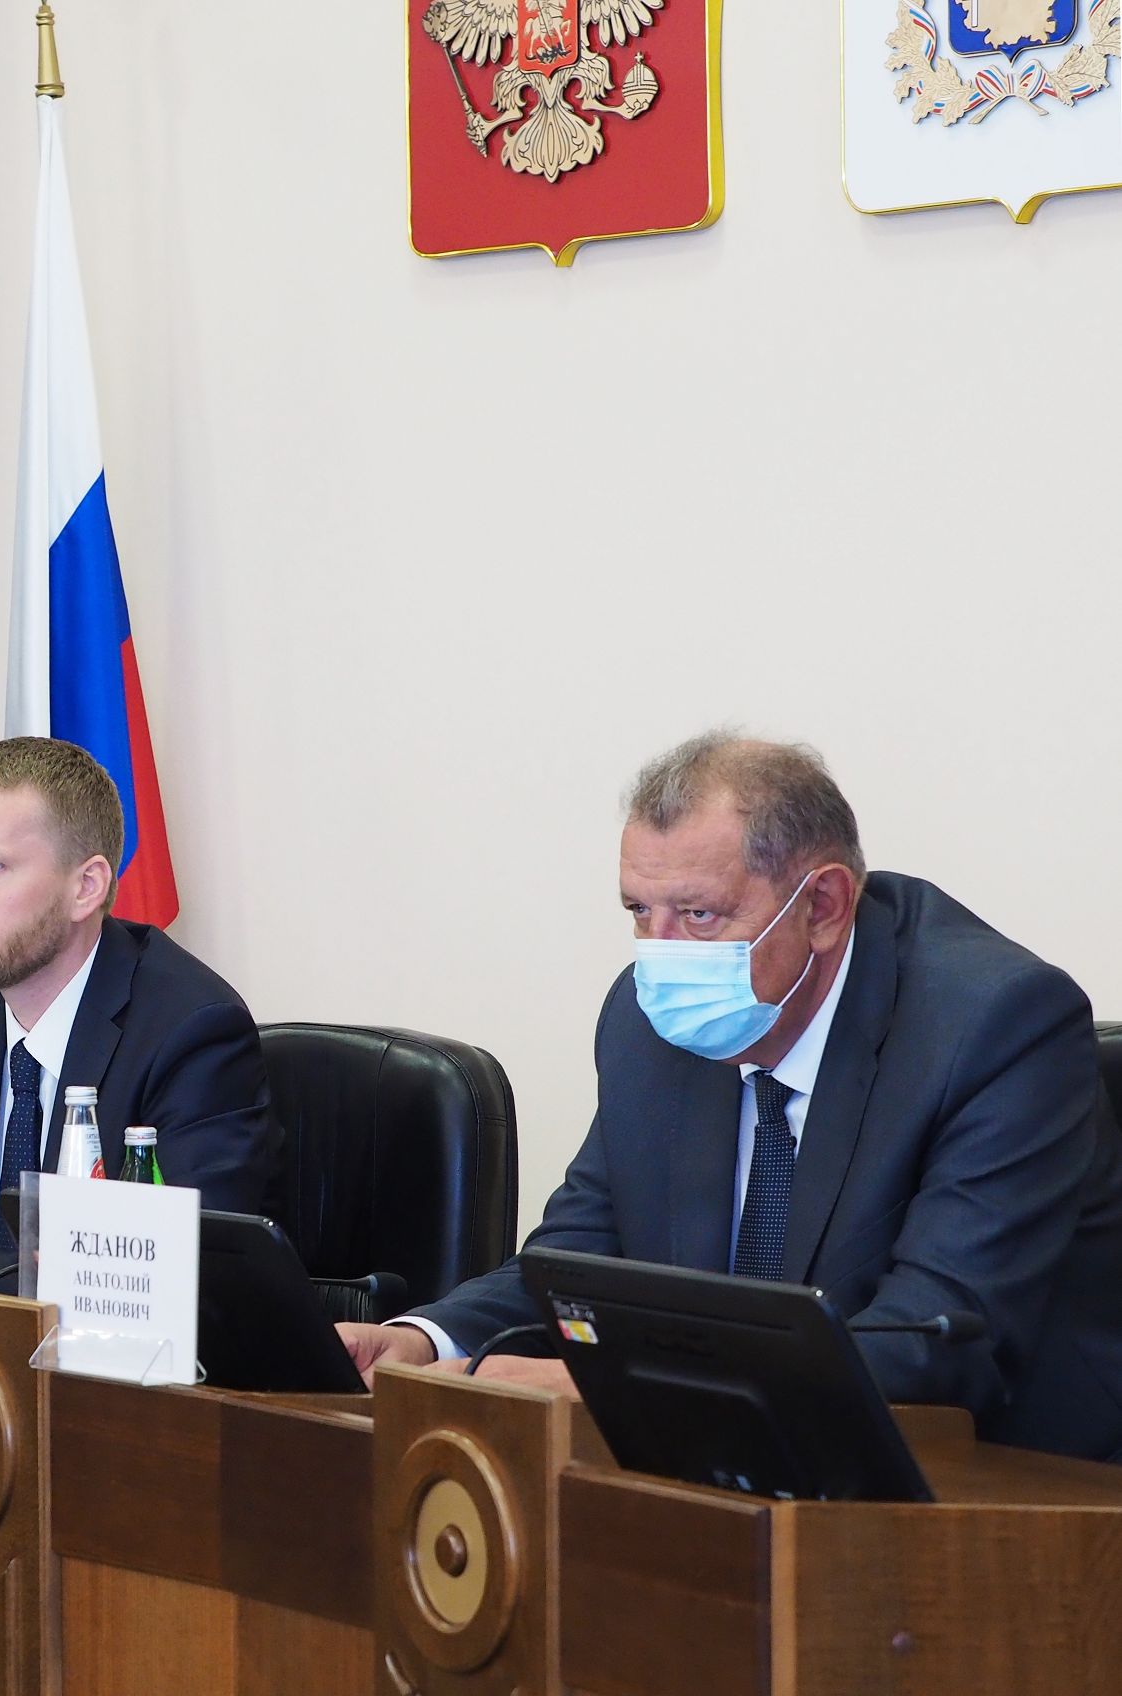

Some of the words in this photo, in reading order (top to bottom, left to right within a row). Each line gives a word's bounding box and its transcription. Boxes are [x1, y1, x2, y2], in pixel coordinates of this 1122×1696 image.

[69, 1229, 156, 1262] ЖДАНОВ
[73, 1269, 151, 1294] АНАТОЛИЙ
[73, 1295, 151, 1321] ИВАНОВИЧ
